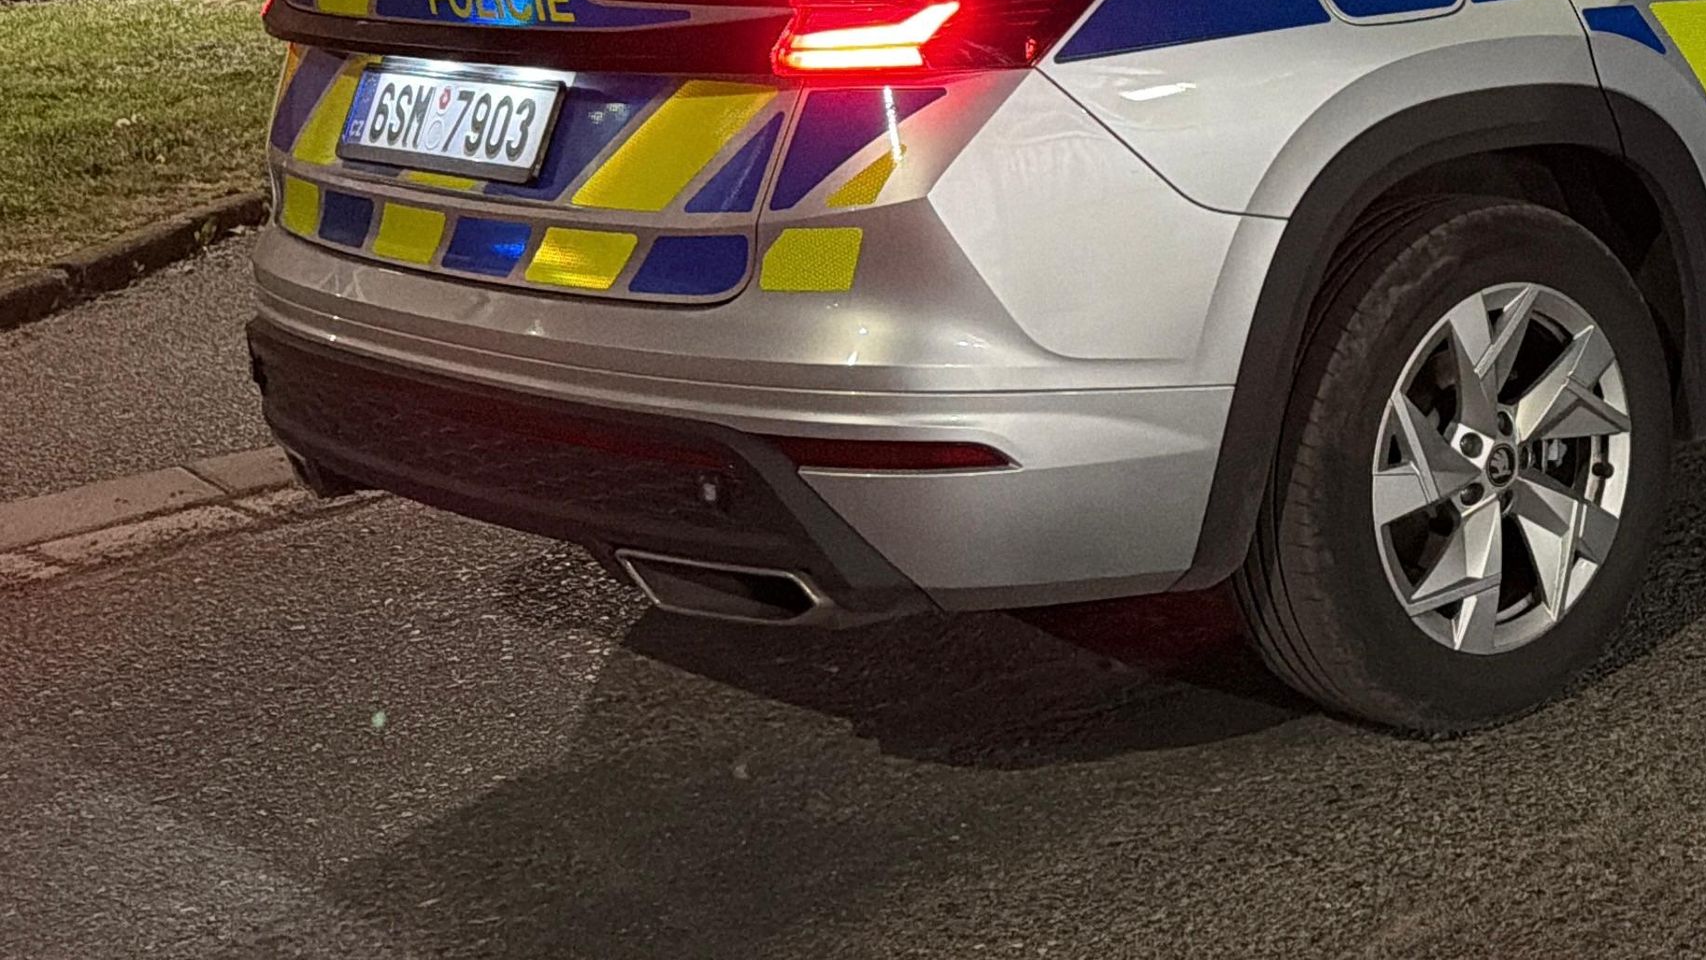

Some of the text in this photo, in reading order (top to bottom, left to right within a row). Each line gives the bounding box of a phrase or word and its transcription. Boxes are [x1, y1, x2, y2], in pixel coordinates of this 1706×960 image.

[350, 119, 364, 137] CZ
[368, 82, 537, 162] 6SM 7903
